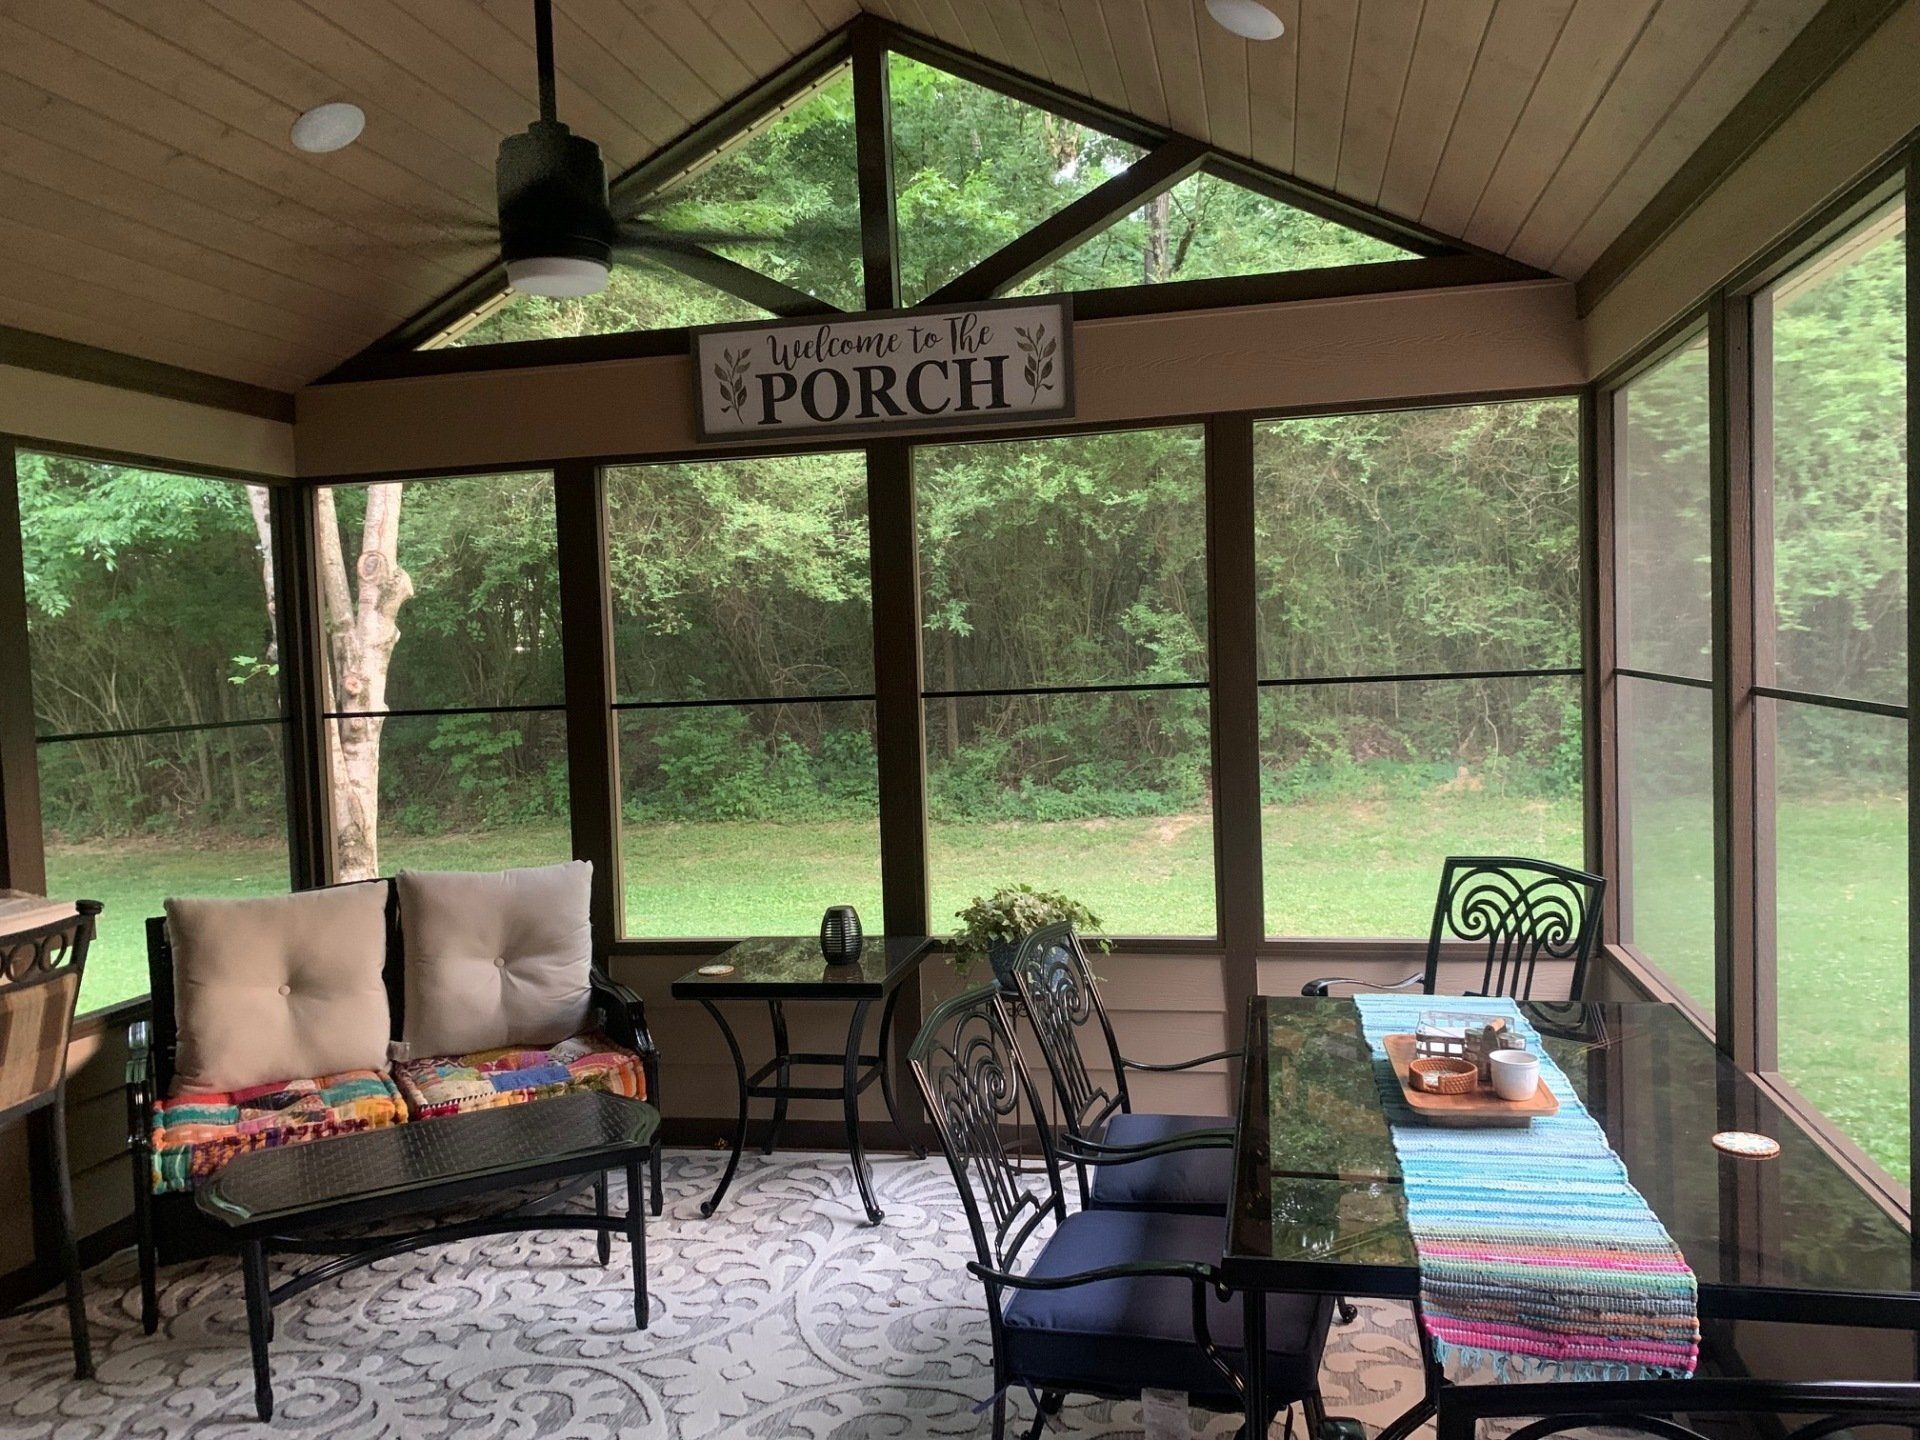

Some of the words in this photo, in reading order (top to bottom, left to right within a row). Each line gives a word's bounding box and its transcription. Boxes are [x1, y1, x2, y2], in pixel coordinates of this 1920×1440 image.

[767, 324, 902, 371] Welcome
[908, 325, 943, 354] to
[944, 312, 993, 354] The
[755, 355, 1011, 425] PORCH
